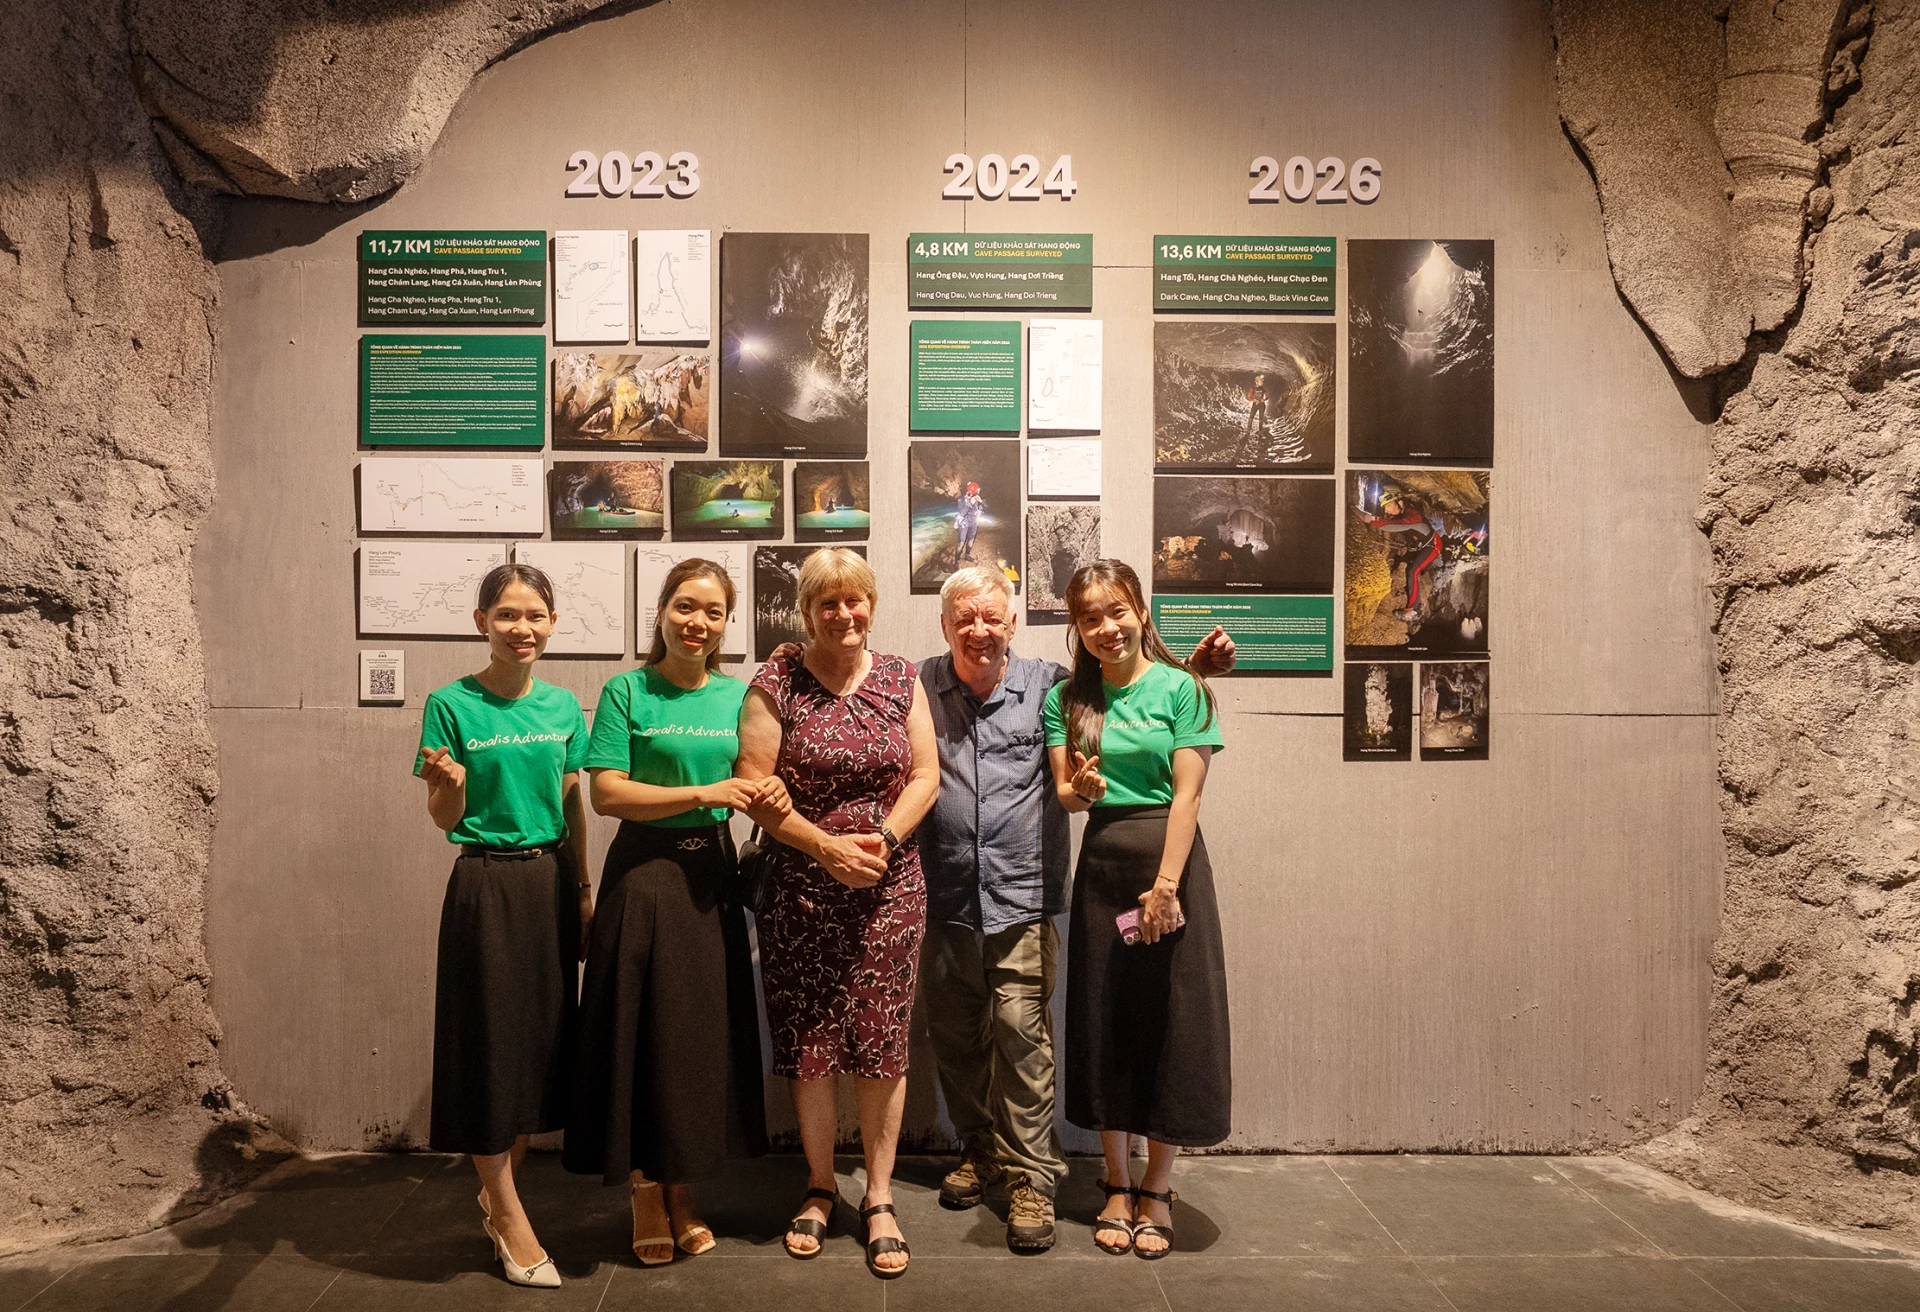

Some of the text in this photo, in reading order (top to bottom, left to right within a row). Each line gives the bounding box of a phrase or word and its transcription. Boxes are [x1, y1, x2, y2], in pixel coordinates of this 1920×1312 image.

[567, 151, 701, 197] 2023
[943, 153, 1077, 199] 2024
[1249, 156, 1382, 203] 2026
[519, 239, 540, 247] ĐỘNG
[975, 241, 986, 249] DỮ
[987, 242, 1002, 250] LIỆU
[1004, 241, 1023, 249] KHẢO
[1024, 241, 1036, 249] SÁT
[1059, 242, 1080, 250] ĐỘNG
[369, 240, 430, 256] 11,7 KM
[915, 242, 968, 258] 4,8 KM
[1161, 245, 1221, 260] 13,6 KM
[1254, 244, 1274, 252] KHẢO
[1275, 244, 1287, 252] SÁT
[1310, 245, 1330, 253] ĐỘNG
[369, 268, 387, 276] Hang
[405, 268, 429, 276] Nghéo,
[431, 268, 450, 276] Hang
[451, 268, 466, 276] Phá,
[468, 268, 486, 276] Hang
[917, 272, 935, 280] Hang
[936, 271, 951, 280] Ông
[952, 272, 968, 280] Đậu,
[986, 272, 1006, 280] Hung,
[1008, 272, 1026, 280] Hang
[1161, 274, 1181, 283] Hang
[1198, 274, 1219, 283] Hang
[1220, 274, 1236, 282] Chà
[1238, 274, 1265, 283] Nghéo,
[1267, 274, 1287, 283] Hang
[1289, 275, 1310, 283] Chạc
[519, 280, 541, 288] Phùng
[1203, 294, 1222, 302] Hang
[1241, 294, 1268, 302] Ngheo,
[513, 308, 534, 316] Phung
[643, 724, 736, 737] Oxalis Adventu
[467, 732, 569, 750] Oxalis Adventur
